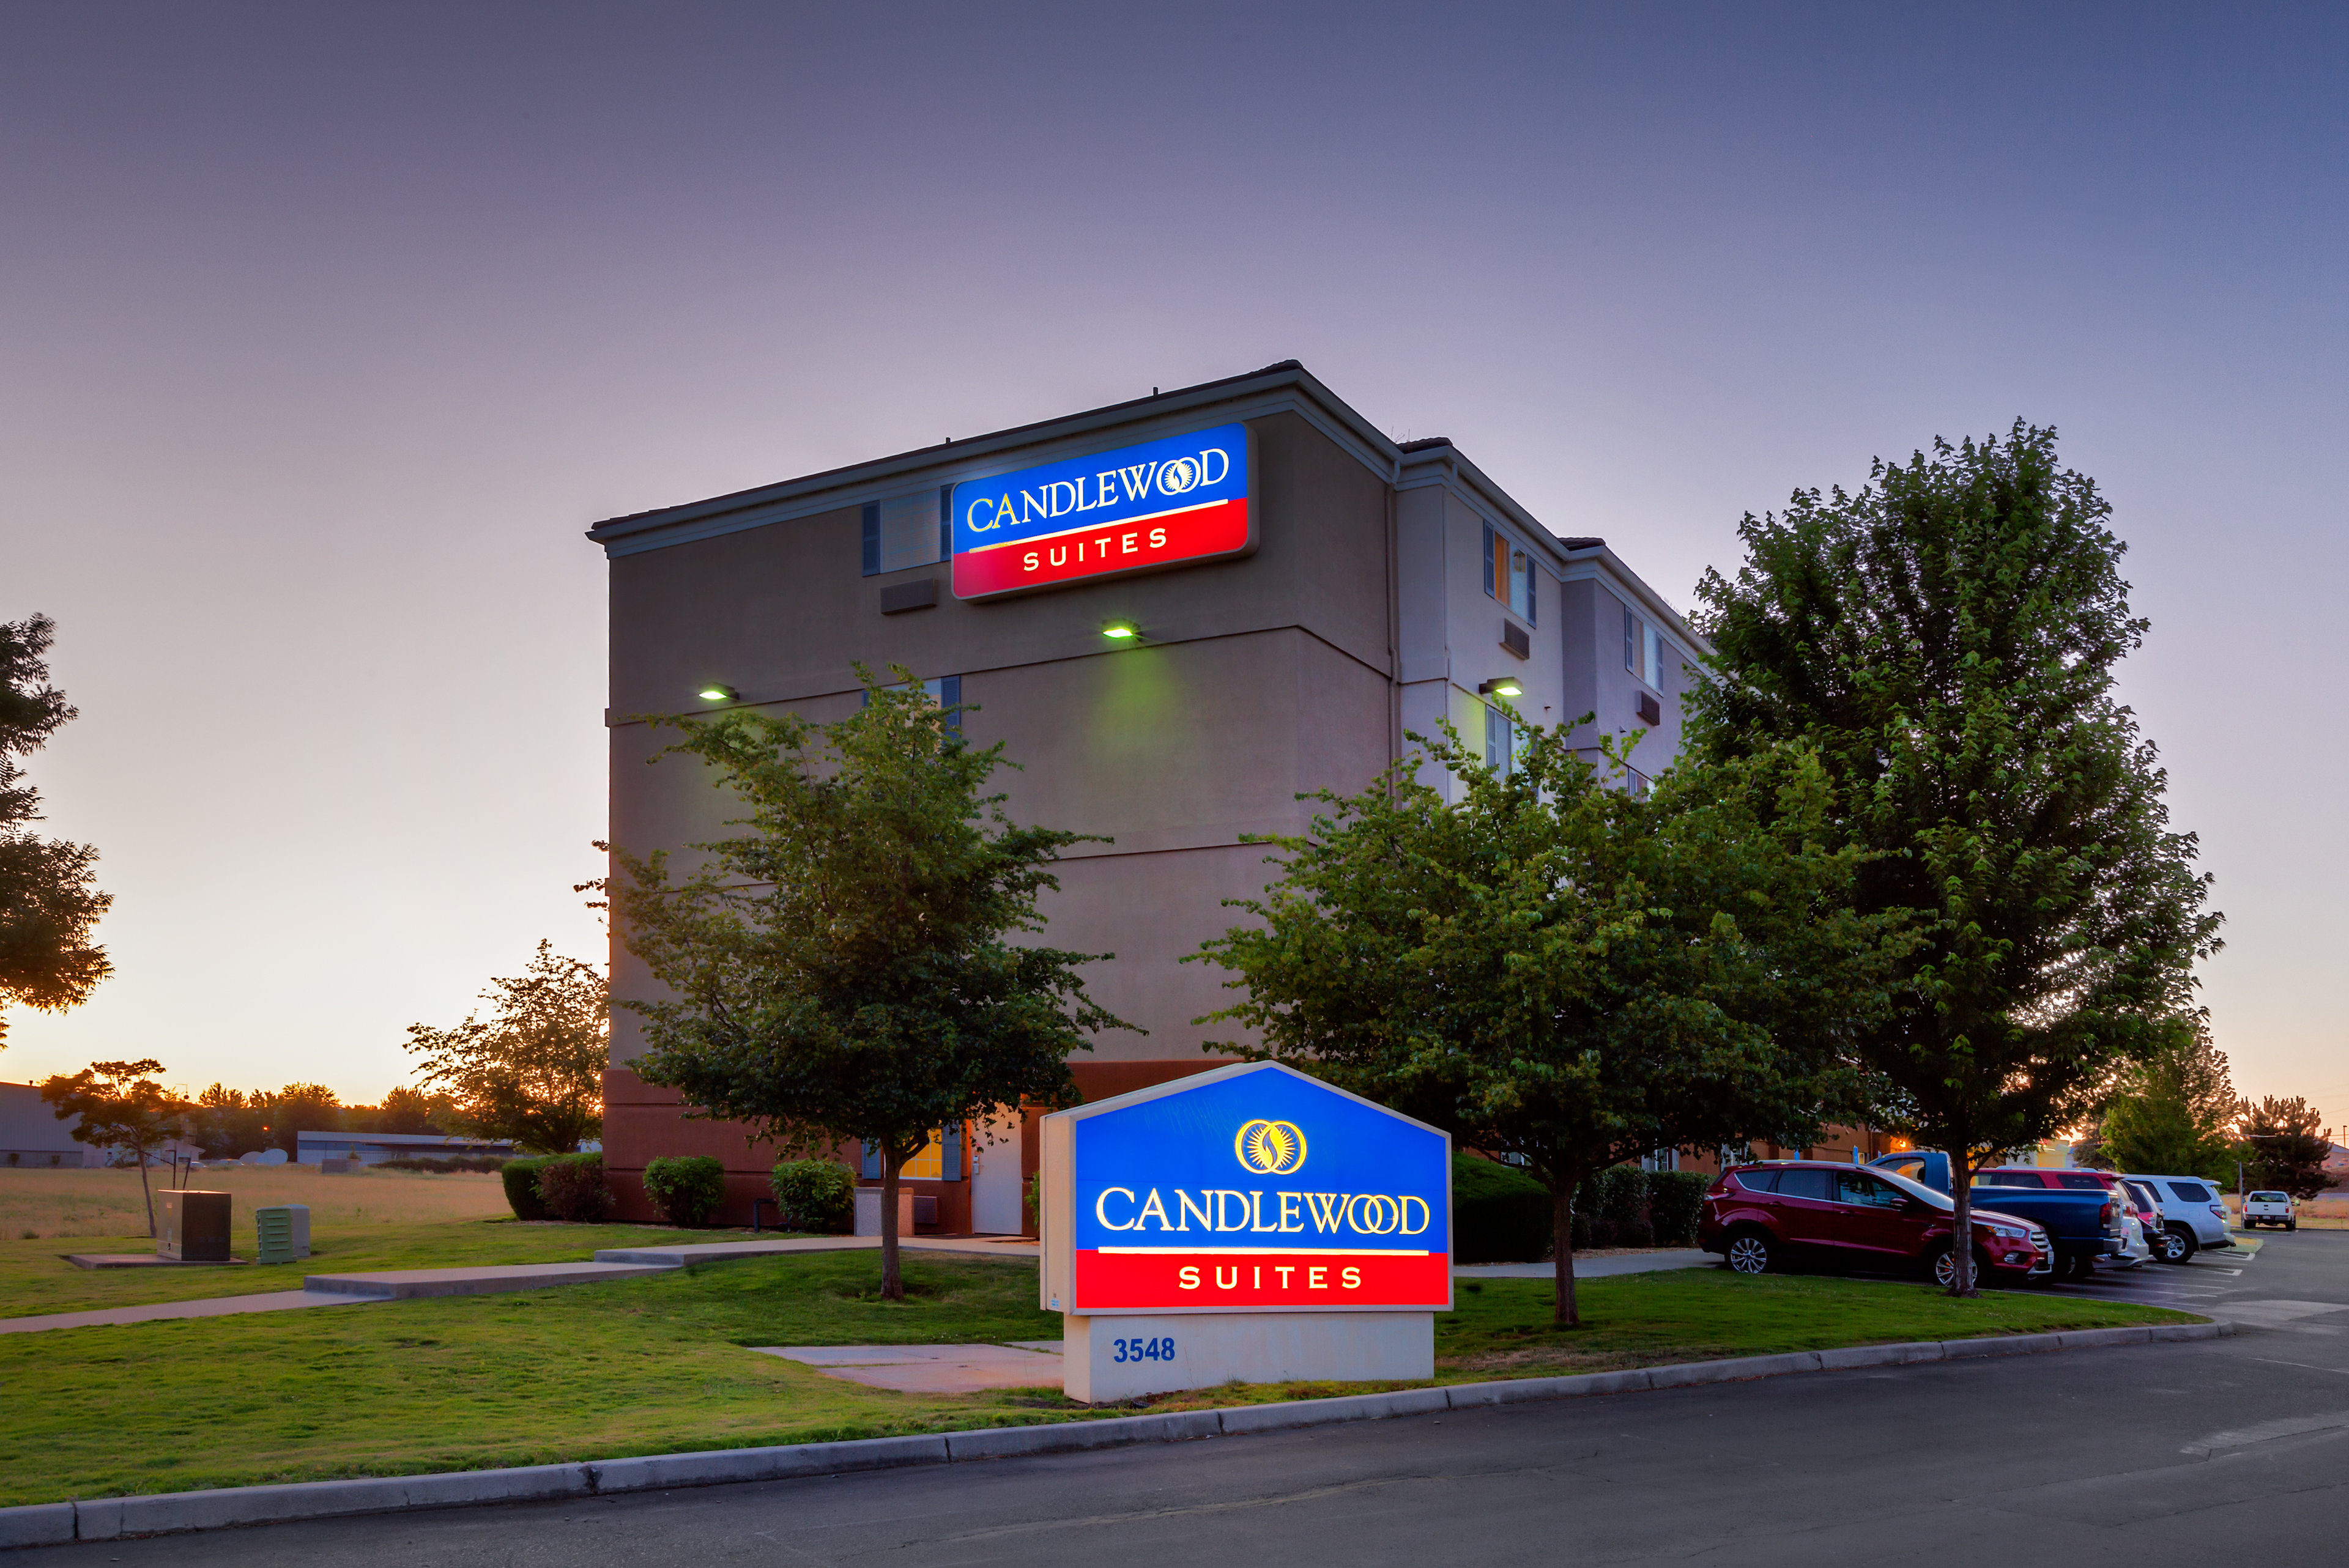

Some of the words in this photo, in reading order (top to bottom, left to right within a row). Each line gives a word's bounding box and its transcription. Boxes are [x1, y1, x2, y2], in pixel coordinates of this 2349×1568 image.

[967, 448, 1229, 532] CANDLEWOOD
[1023, 528, 1167, 571] SUITES
[1096, 1187, 1430, 1235] CANDLEWOOD
[1178, 1266, 1362, 1289] SUITES
[1113, 1337, 1176, 1363] 3548
